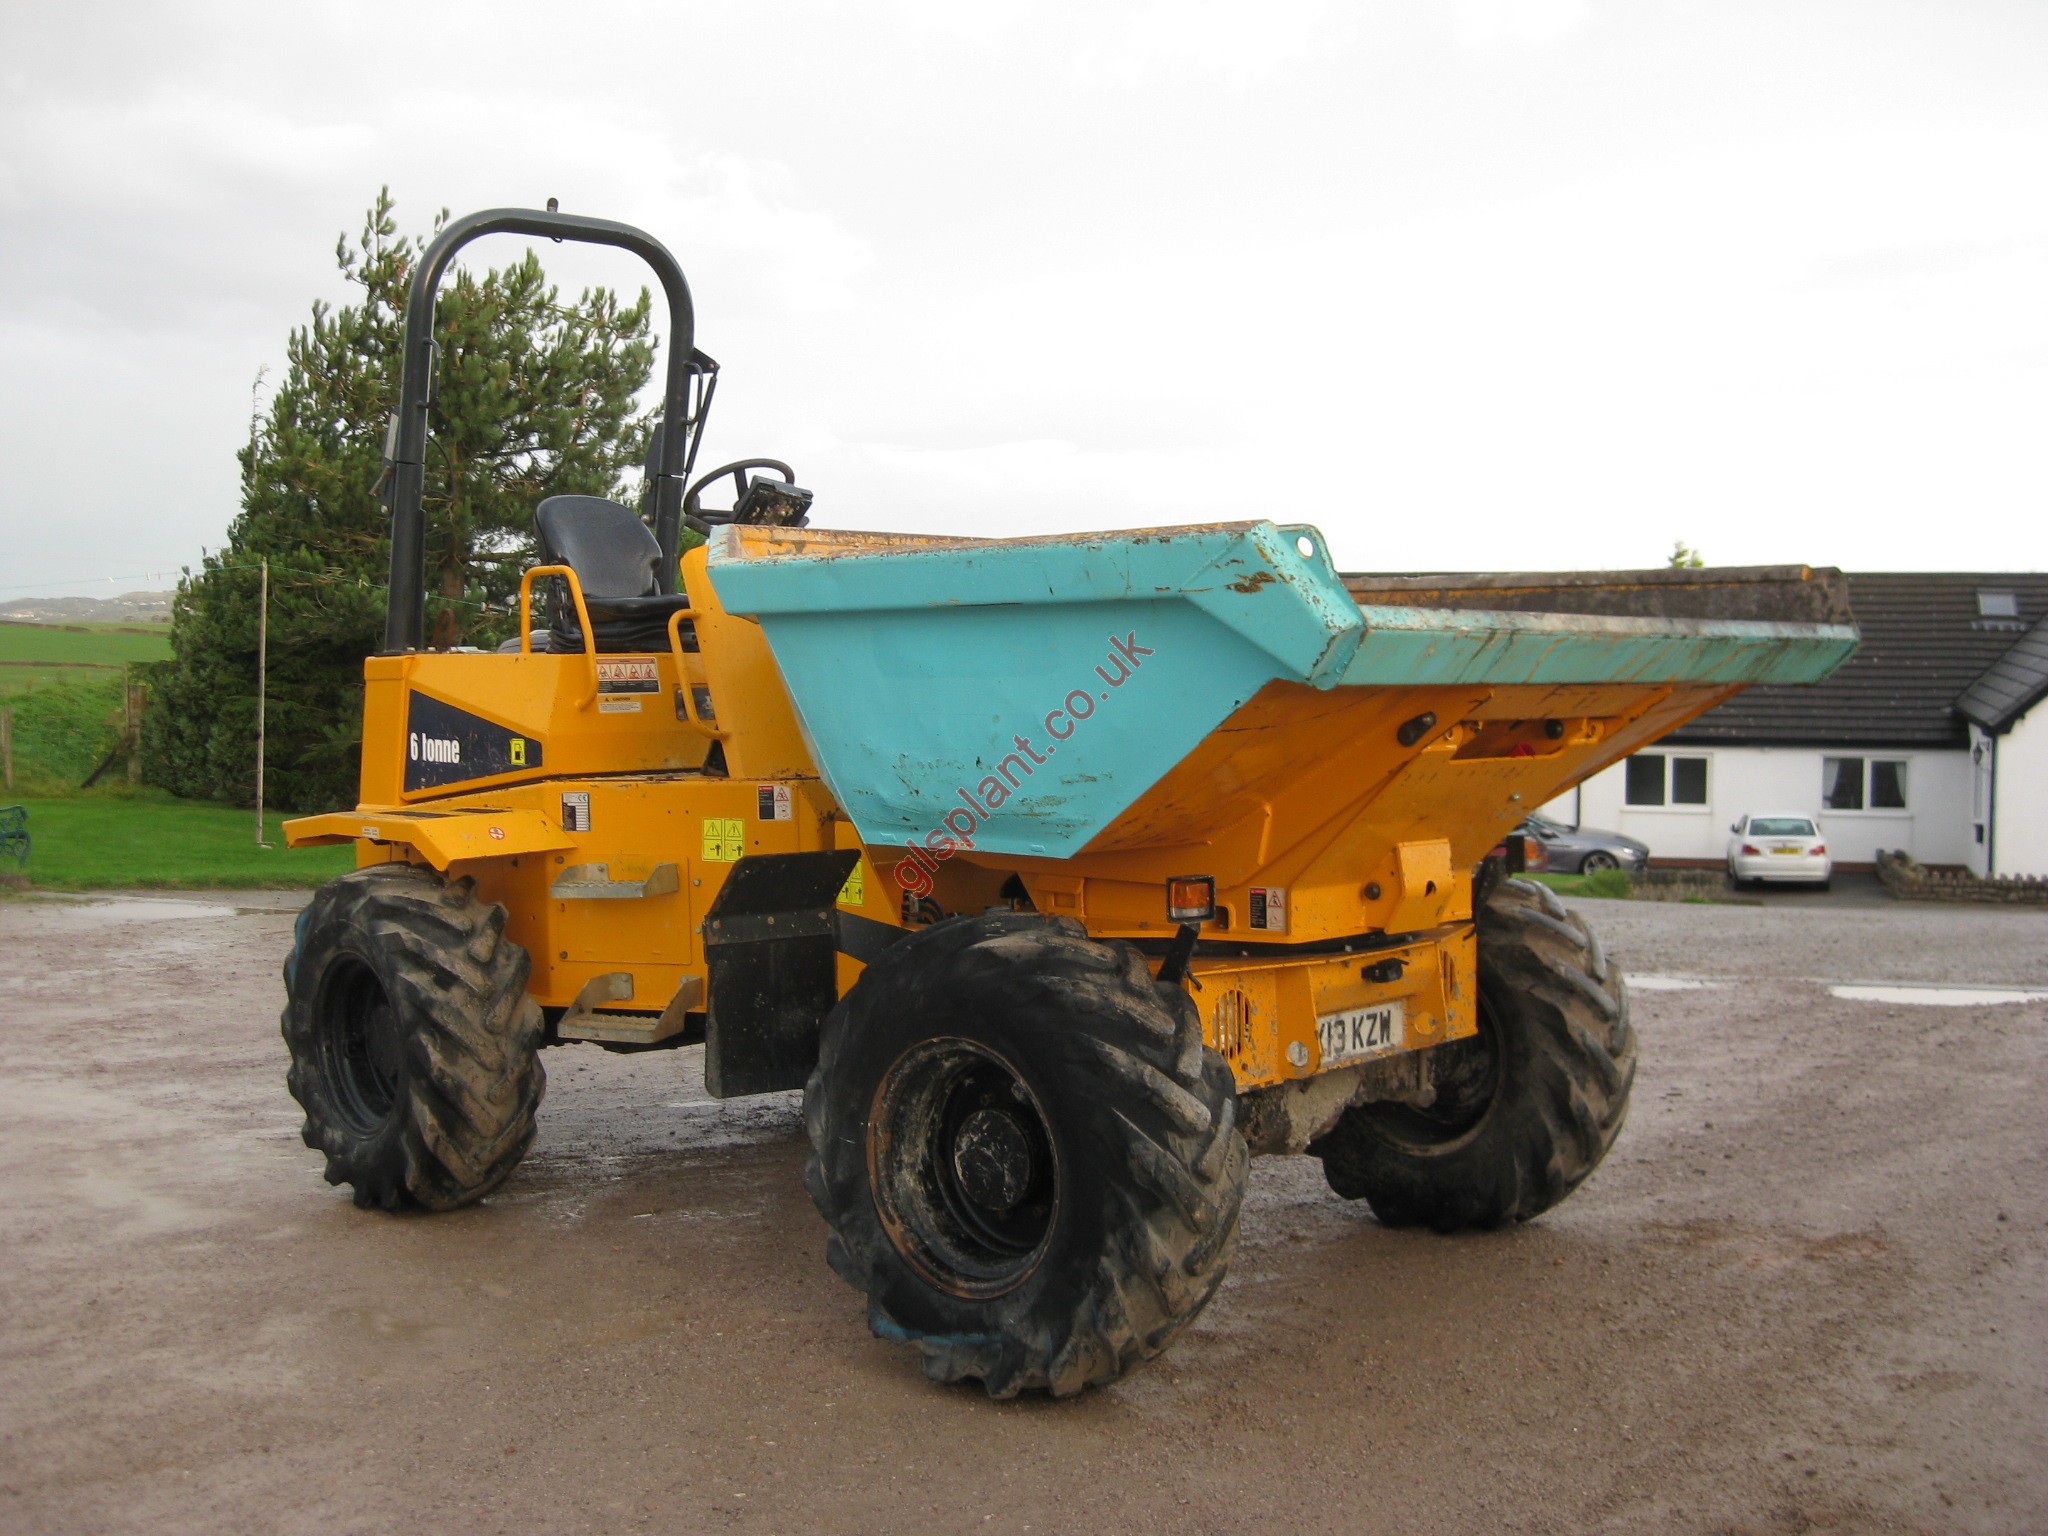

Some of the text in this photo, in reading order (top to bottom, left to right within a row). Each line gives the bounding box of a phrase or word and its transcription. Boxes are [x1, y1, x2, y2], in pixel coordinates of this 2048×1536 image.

[410, 733, 460, 764] 6 tonne
[1352, 1009, 1391, 1050] KZW
